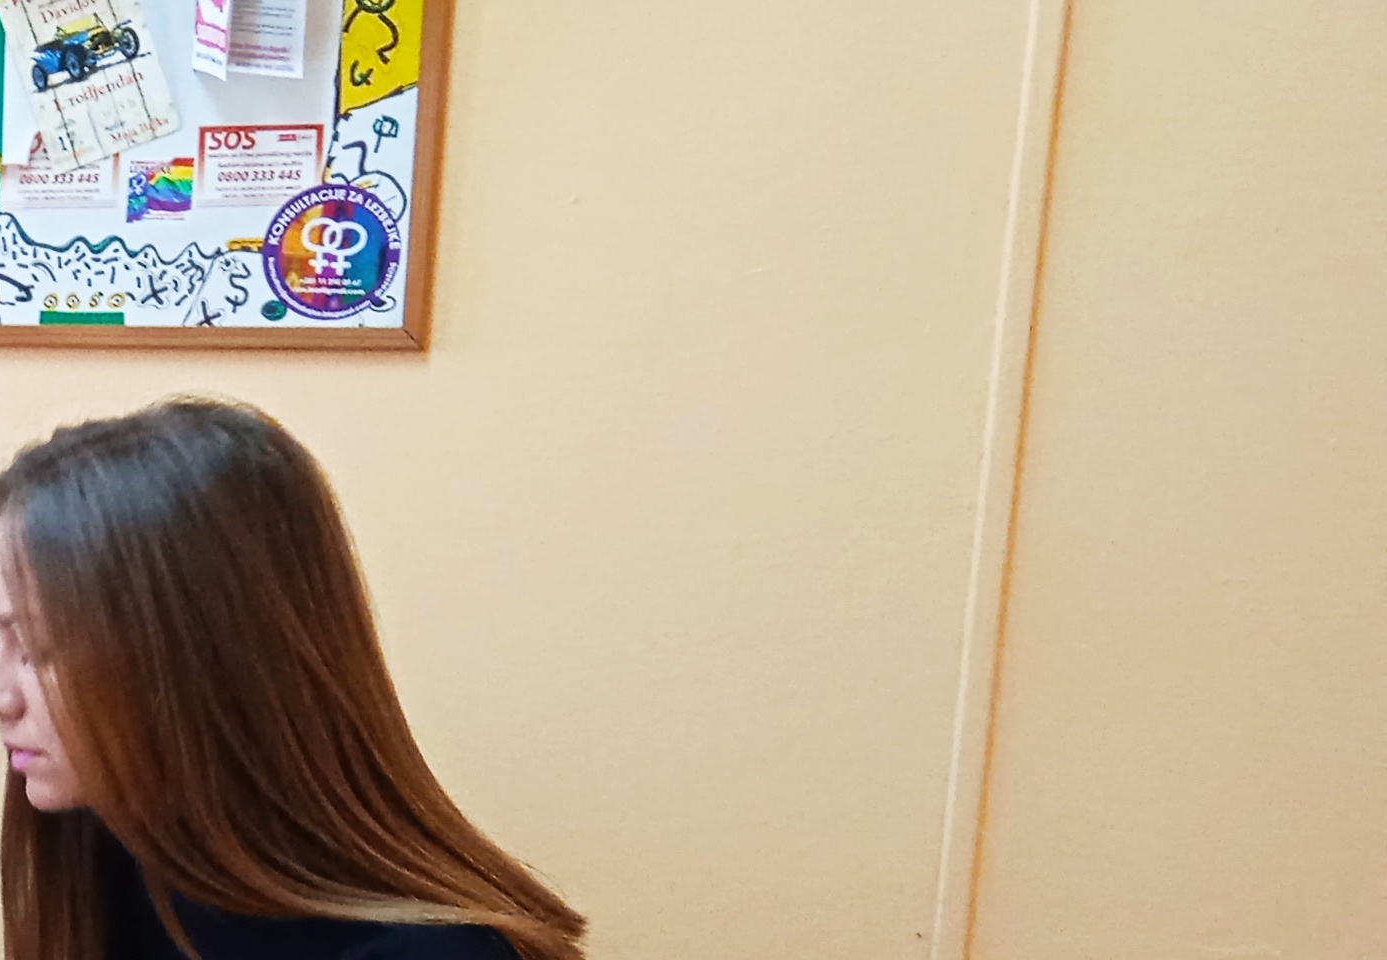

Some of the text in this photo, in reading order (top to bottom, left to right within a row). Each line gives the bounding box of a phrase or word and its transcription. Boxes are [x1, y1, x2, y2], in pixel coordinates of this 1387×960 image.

[68, 70, 144, 107] rodjendan
[208, 129, 255, 151] SOS
[18, 172, 100, 185] 0800 333 445
[218, 170, 302, 182] 0800 333 445
[267, 188, 402, 250] KONSULTACIJE ZA LEZBEJKE
